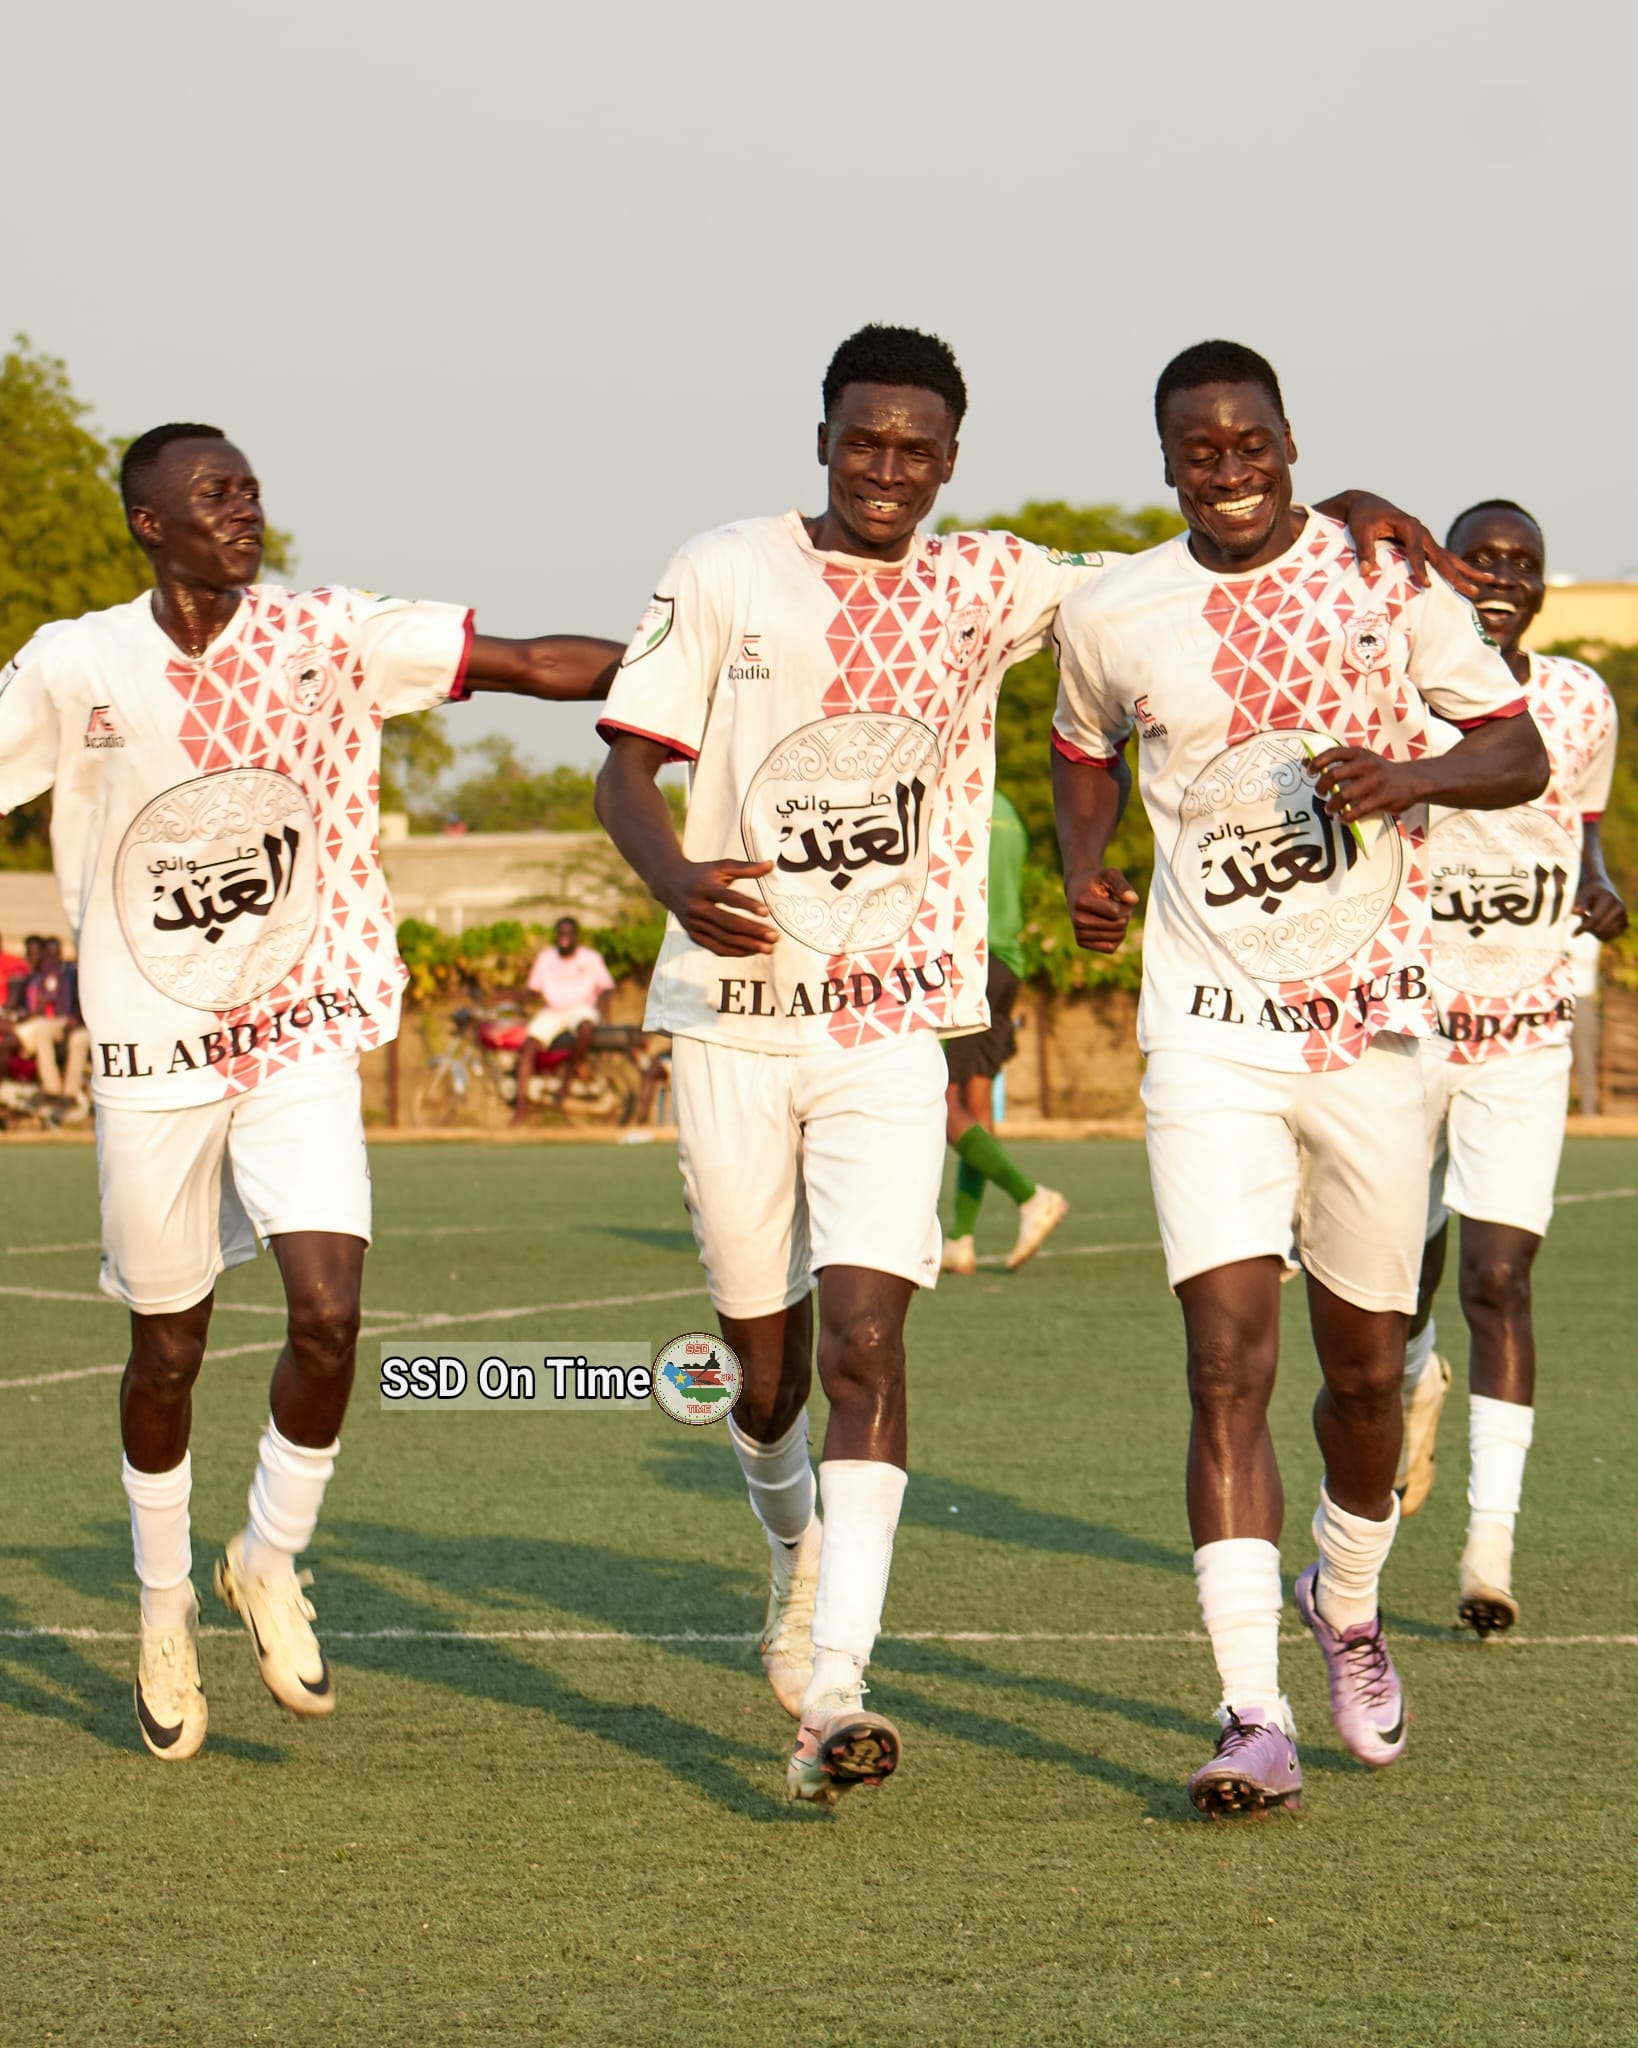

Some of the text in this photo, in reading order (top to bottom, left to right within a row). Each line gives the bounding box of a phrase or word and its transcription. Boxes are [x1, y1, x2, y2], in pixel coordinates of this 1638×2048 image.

[776, 792, 891, 818] حلواني
[147, 847, 260, 877] حلواني
[716, 953, 953, 1018] EL ABD JU
[1186, 965, 1432, 1033] EL ABD JUB
[98, 987, 371, 1077] EL ABD JUBA
